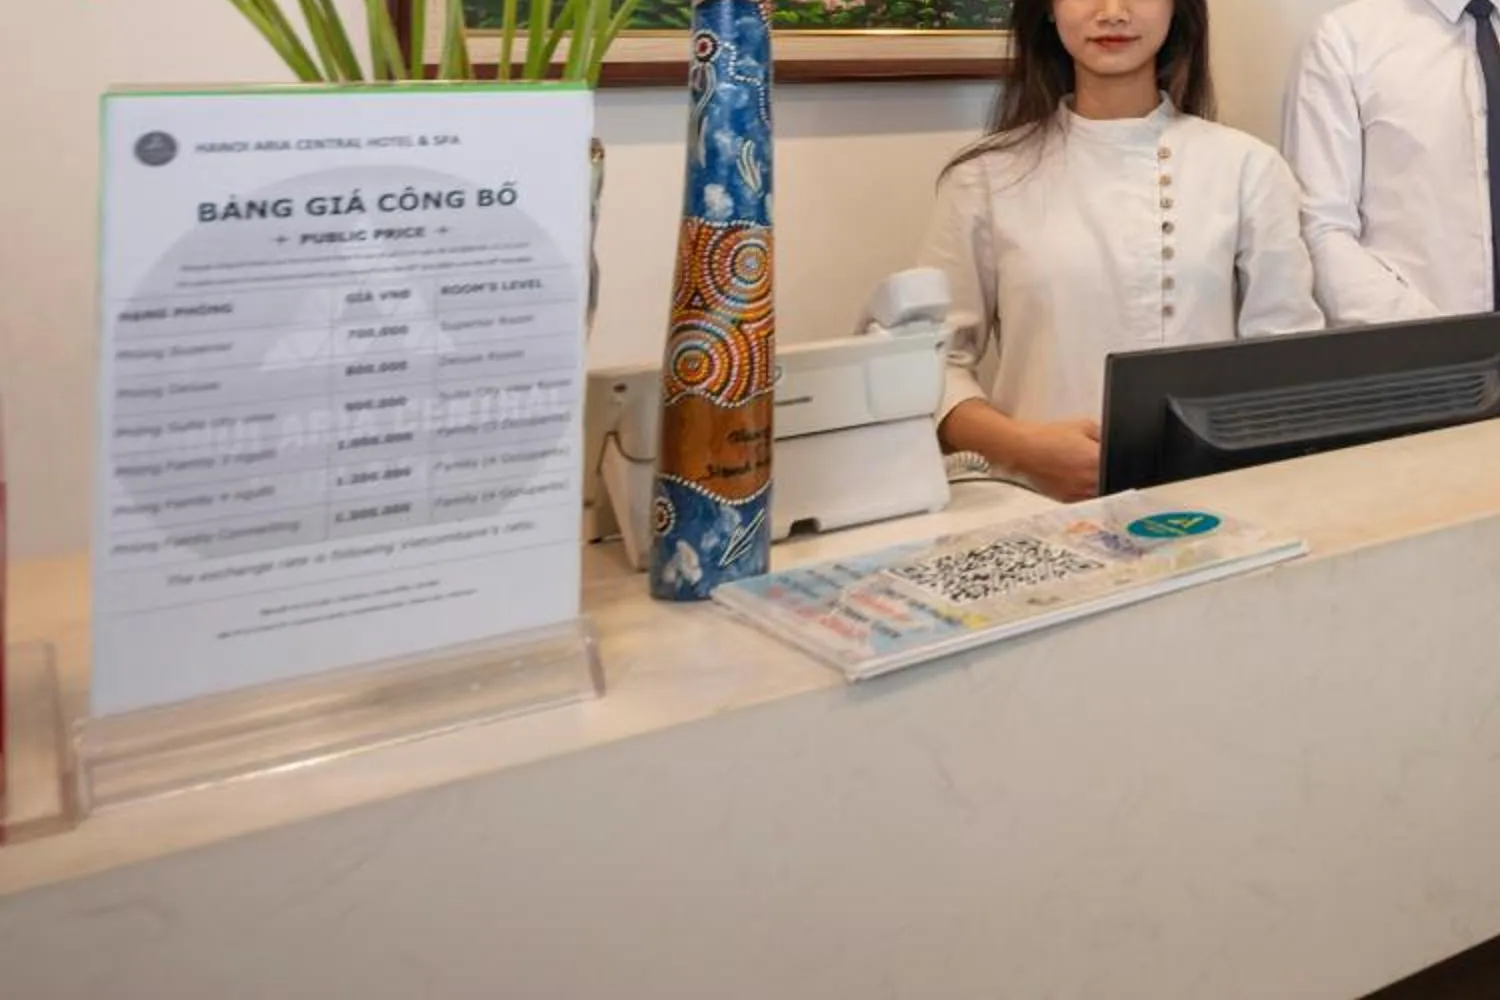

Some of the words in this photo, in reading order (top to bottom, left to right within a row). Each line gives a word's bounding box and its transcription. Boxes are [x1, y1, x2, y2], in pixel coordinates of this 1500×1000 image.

[197, 193, 293, 223] BẢNG
[304, 188, 366, 216] GIÁ
[377, 186, 466, 213] CÔNG
[477, 180, 518, 207] BỐ
[300, 229, 367, 244] PUBLIC
[373, 226, 426, 241] PRICE
